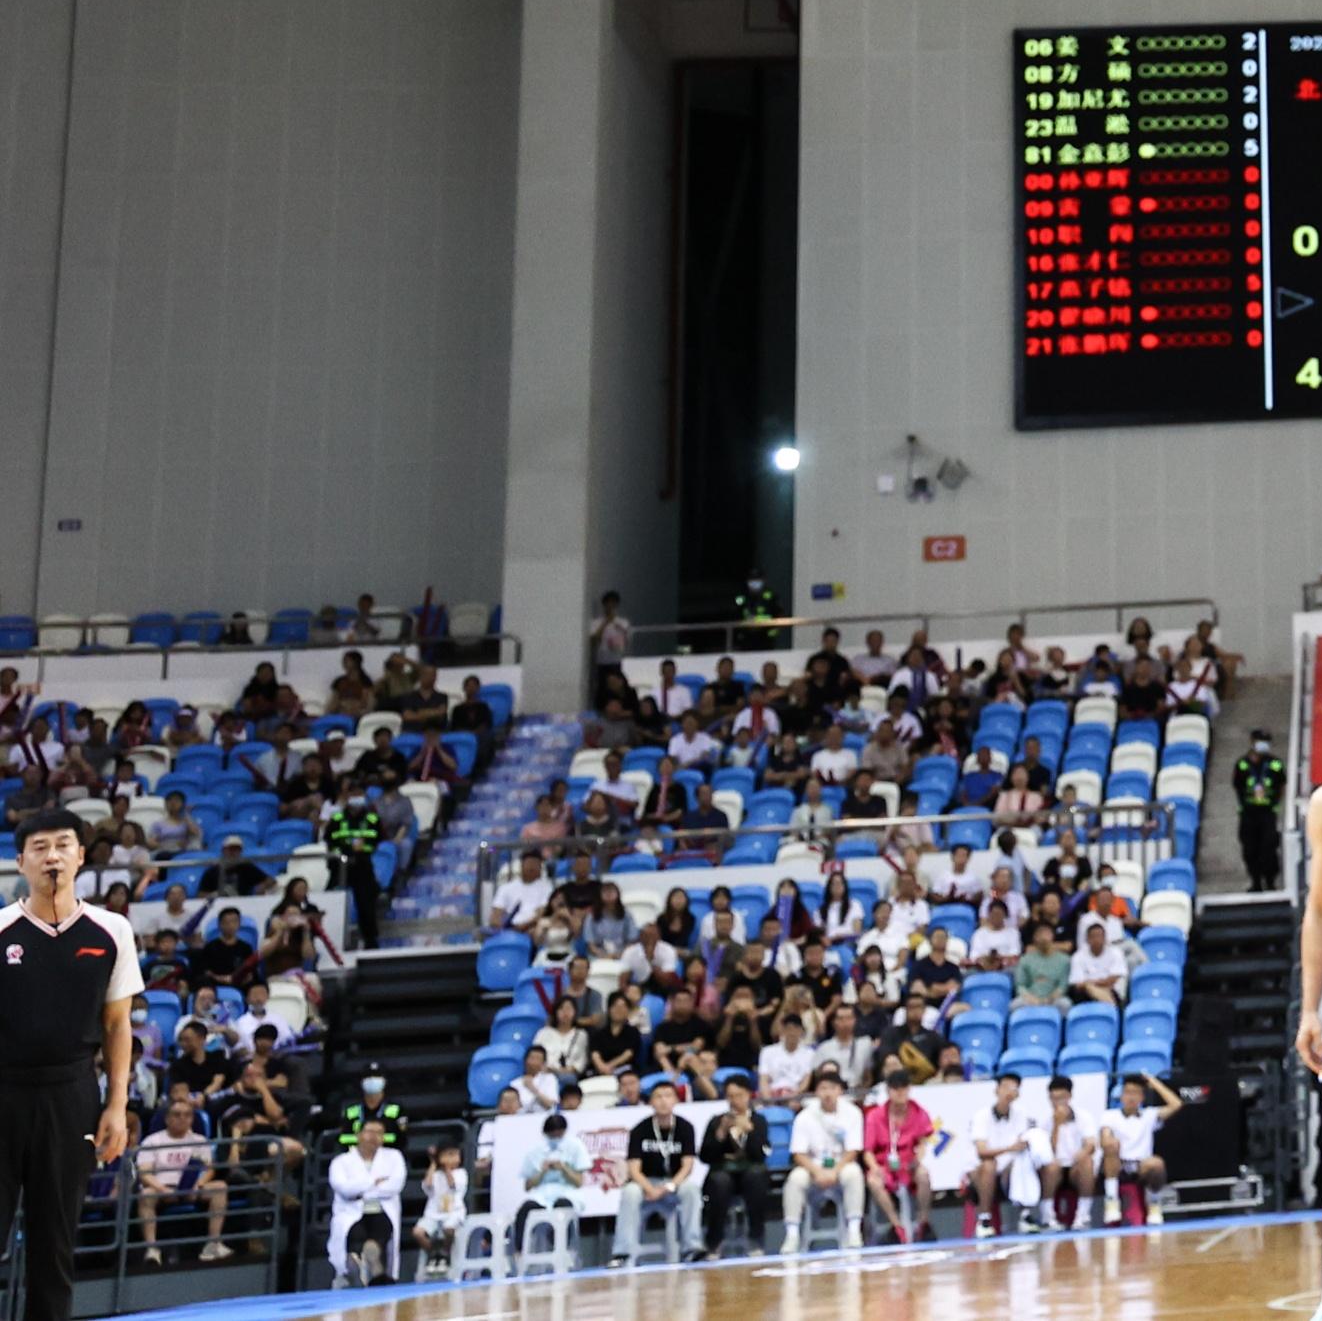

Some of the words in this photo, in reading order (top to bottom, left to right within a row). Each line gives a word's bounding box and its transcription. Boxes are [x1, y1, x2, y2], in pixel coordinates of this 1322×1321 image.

[1024, 38, 1053, 57] 06
[1242, 32, 1257, 51] 2
[1024, 65, 1053, 84] 08
[1242, 58, 1258, 77] 0
[1026, 91, 1053, 110] 19
[1242, 85, 1258, 104] 2
[1024, 118, 1053, 138] 23
[1243, 111, 1258, 131] 0
[1243, 138, 1259, 157] 5
[1243, 165, 1260, 184] 0
[1244, 192, 1261, 211] 0
[1244, 219, 1261, 238] 0
[1292, 225, 1319, 256] 0
[1245, 246, 1262, 265] 0
[1027, 281, 1053, 300] 17
[1246, 301, 1262, 320] 0
[1025, 336, 1053, 356] 21
[1246, 329, 1263, 348] 0
[1295, 357, 1322, 389] 4
